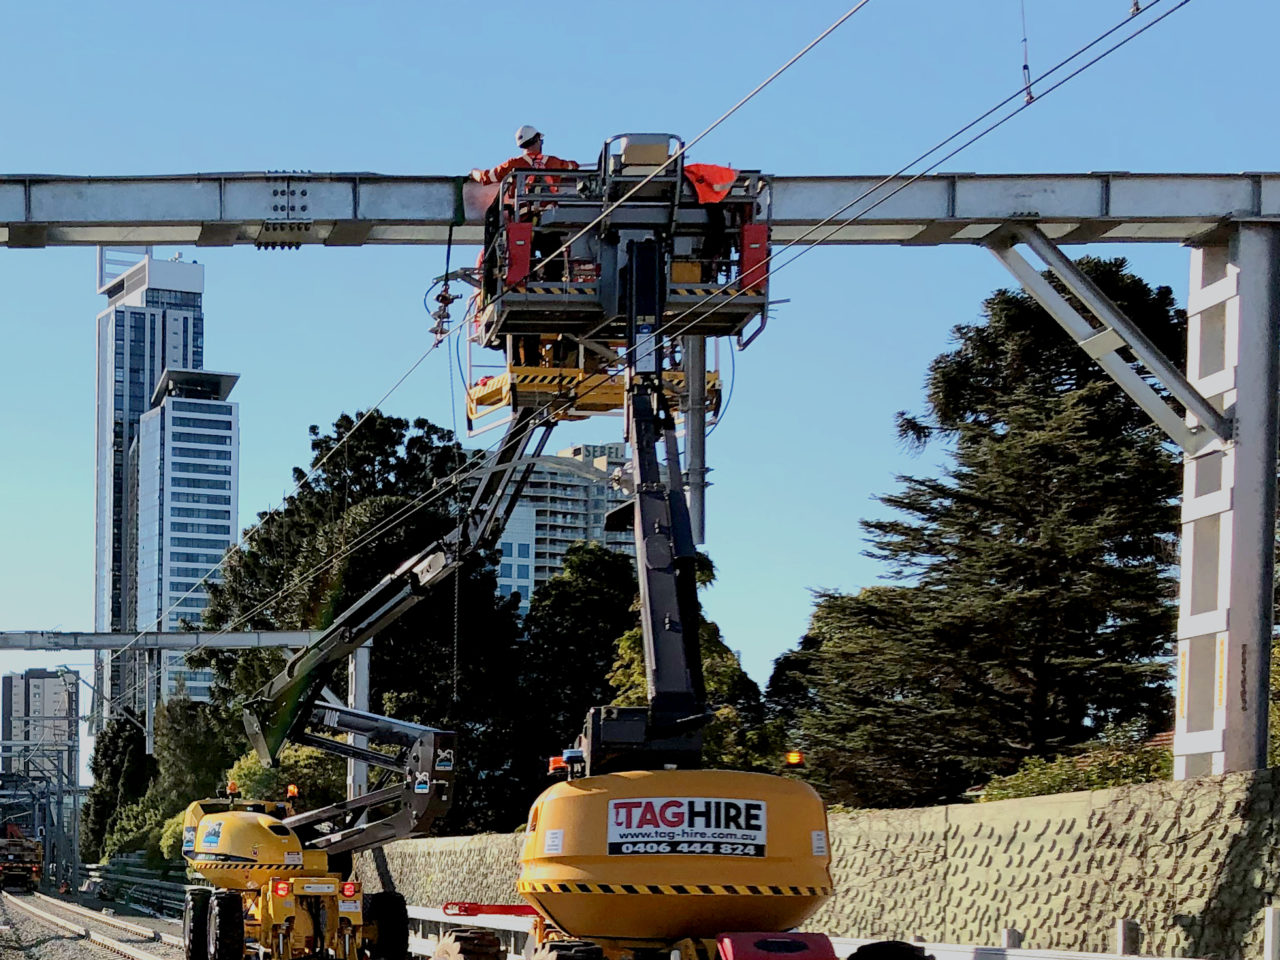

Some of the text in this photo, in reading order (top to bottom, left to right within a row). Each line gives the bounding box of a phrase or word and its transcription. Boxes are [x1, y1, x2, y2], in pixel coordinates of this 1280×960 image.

[619, 829, 757, 841] www.tag-hire.com.au
[622, 843, 756, 855] 0406 444 824
